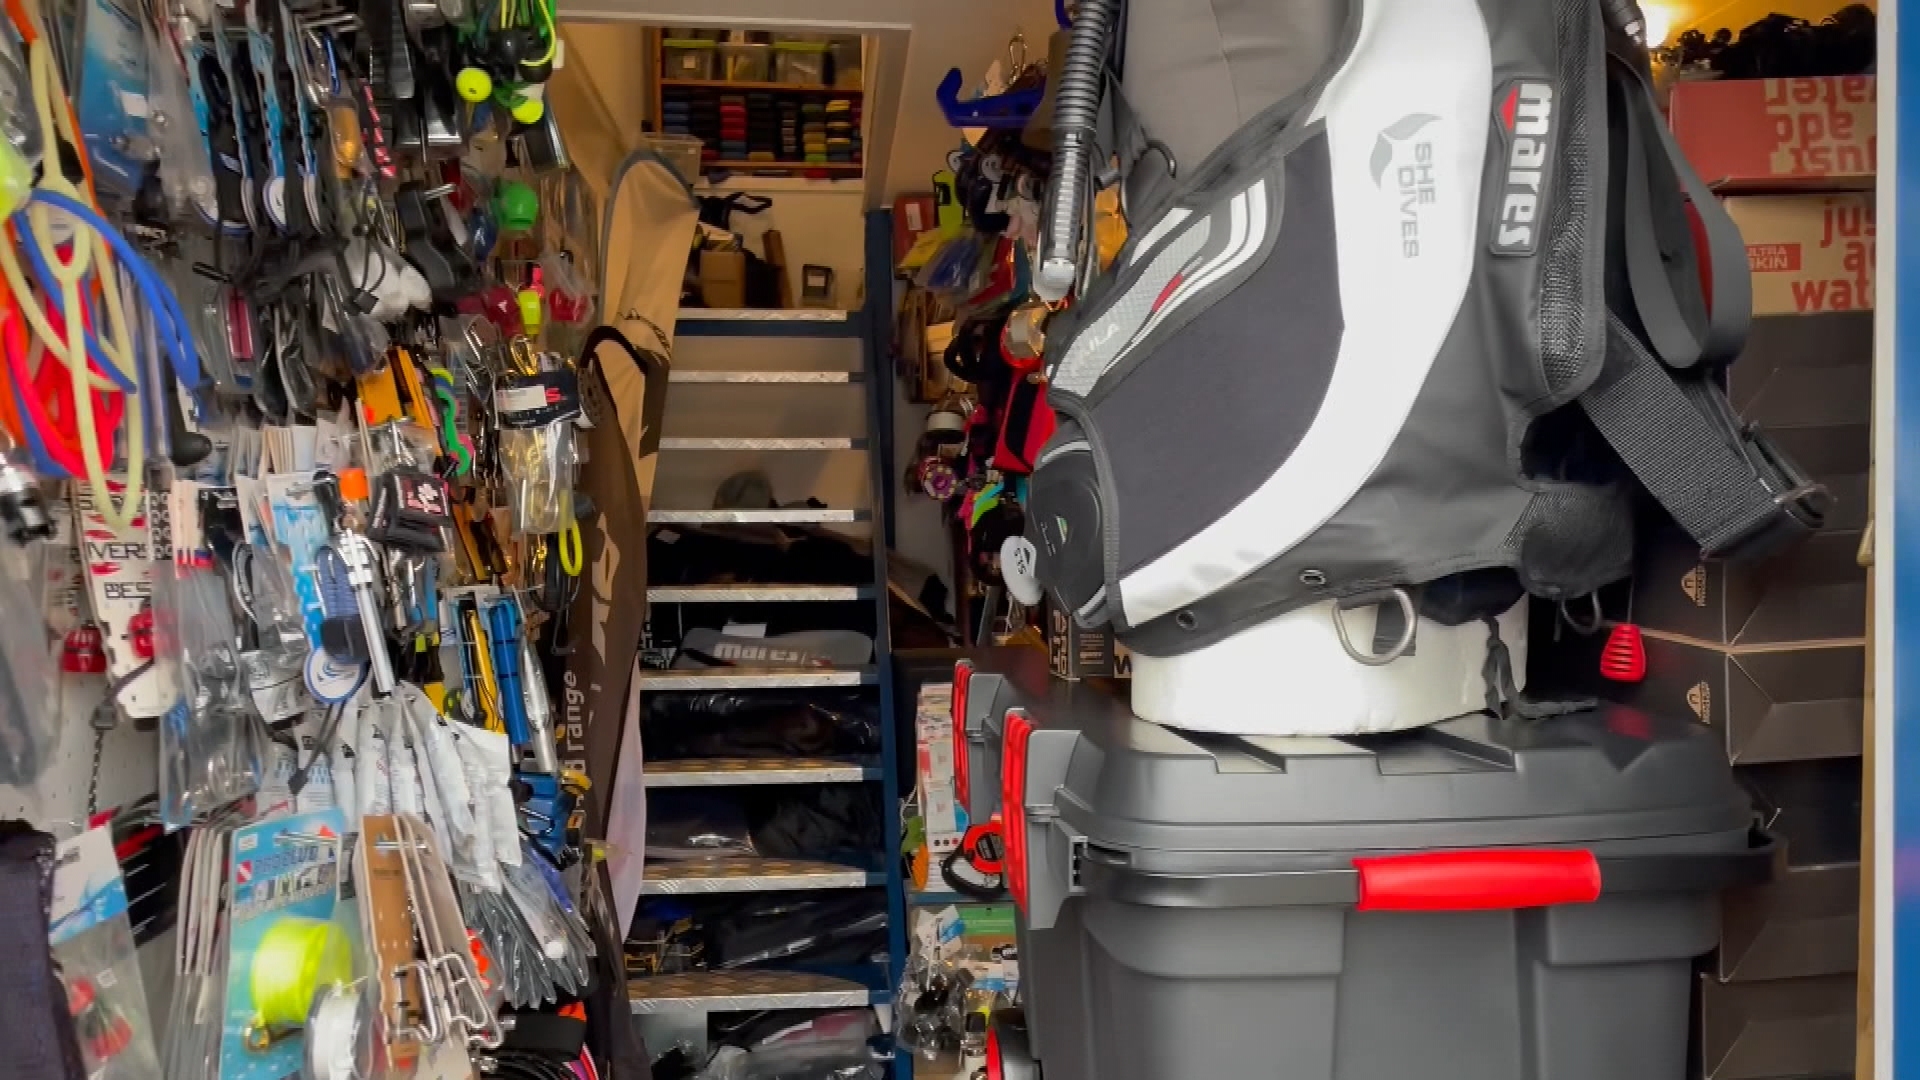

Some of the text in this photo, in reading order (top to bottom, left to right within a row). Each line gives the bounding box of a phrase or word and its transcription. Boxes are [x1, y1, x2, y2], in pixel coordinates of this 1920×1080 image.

[1765, 77, 1877, 104] ater
[1415, 142, 1436, 204] SHE
[1499, 84, 1552, 246] mares
[1398, 166, 1419, 258] DIVES
[1791, 280, 1872, 311] wat
[563, 670, 585, 751] range
